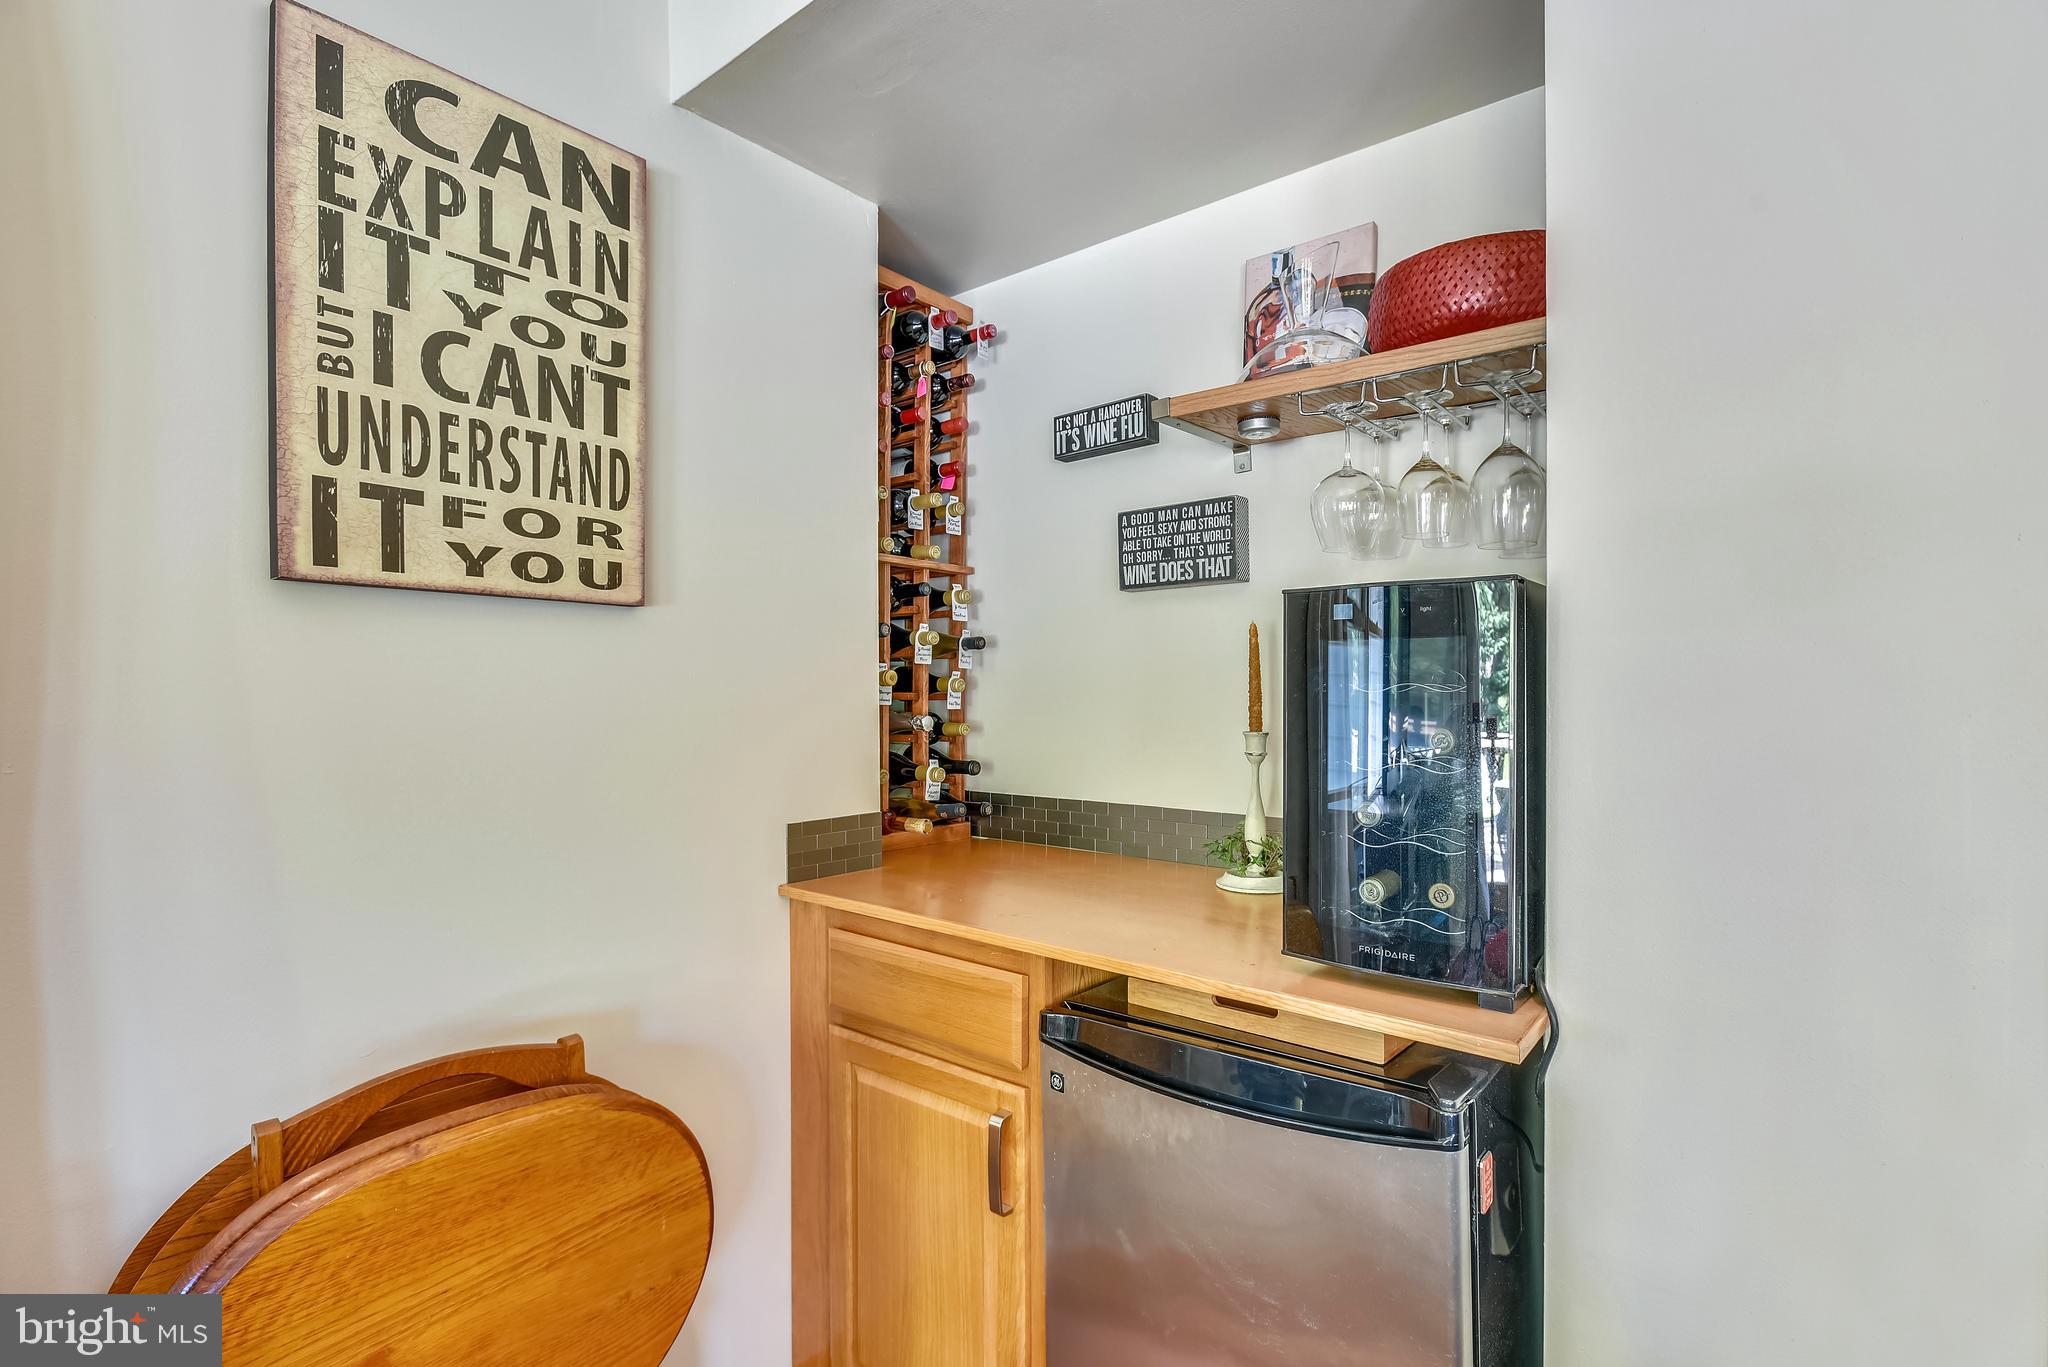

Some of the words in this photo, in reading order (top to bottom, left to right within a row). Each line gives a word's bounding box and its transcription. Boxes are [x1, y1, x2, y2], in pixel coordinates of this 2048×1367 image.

[315, 34, 344, 119] I
[384, 79, 631, 231] CAN
[318, 124, 630, 302] EXPLAIN
[318, 205, 430, 312] IT
[446, 250, 629, 330] TO
[316, 294, 355, 379] BUT
[372, 310, 394, 388] I
[442, 289, 627, 368] YOU
[1056, 416, 1071, 432] IT'S
[1073, 411, 1089, 428] NOT
[1090, 409, 1097, 424] A
[1056, 427, 1080, 455] IT'S
[1083, 418, 1118, 449] WINE
[1120, 411, 1144, 440] FLU
[316, 385, 631, 512] UNDERSTAND
[311, 474, 425, 574] IT
[442, 495, 625, 551] FOR
[1122, 515, 1128, 527] A
[1131, 511, 1155, 526] GOOD
[1158, 508, 1178, 522] MAN
[1182, 504, 1201, 519] CAN
[1205, 500, 1233, 516] MAKE
[1122, 526, 1137, 539] YOU
[1138, 524, 1156, 537] FEEL
[1158, 521, 1178, 535] SEXY
[1180, 519, 1197, 532] AND
[444, 540, 623, 591] YOU
[1122, 539, 1141, 552] ABLE
[1142, 537, 1152, 549] TO
[1153, 535, 1172, 548] TAKE
[1173, 533, 1184, 546] ON
[1185, 531, 1201, 545] THE
[1122, 552, 1134, 564] OH
[1173, 544, 1204, 559] THAT'S
[1123, 563, 1157, 586] WINE
[1160, 559, 1194, 583] DOES
[1196, 555, 1232, 579] THAT
[1358, 945, 1416, 962] FRIGIDAIRE
